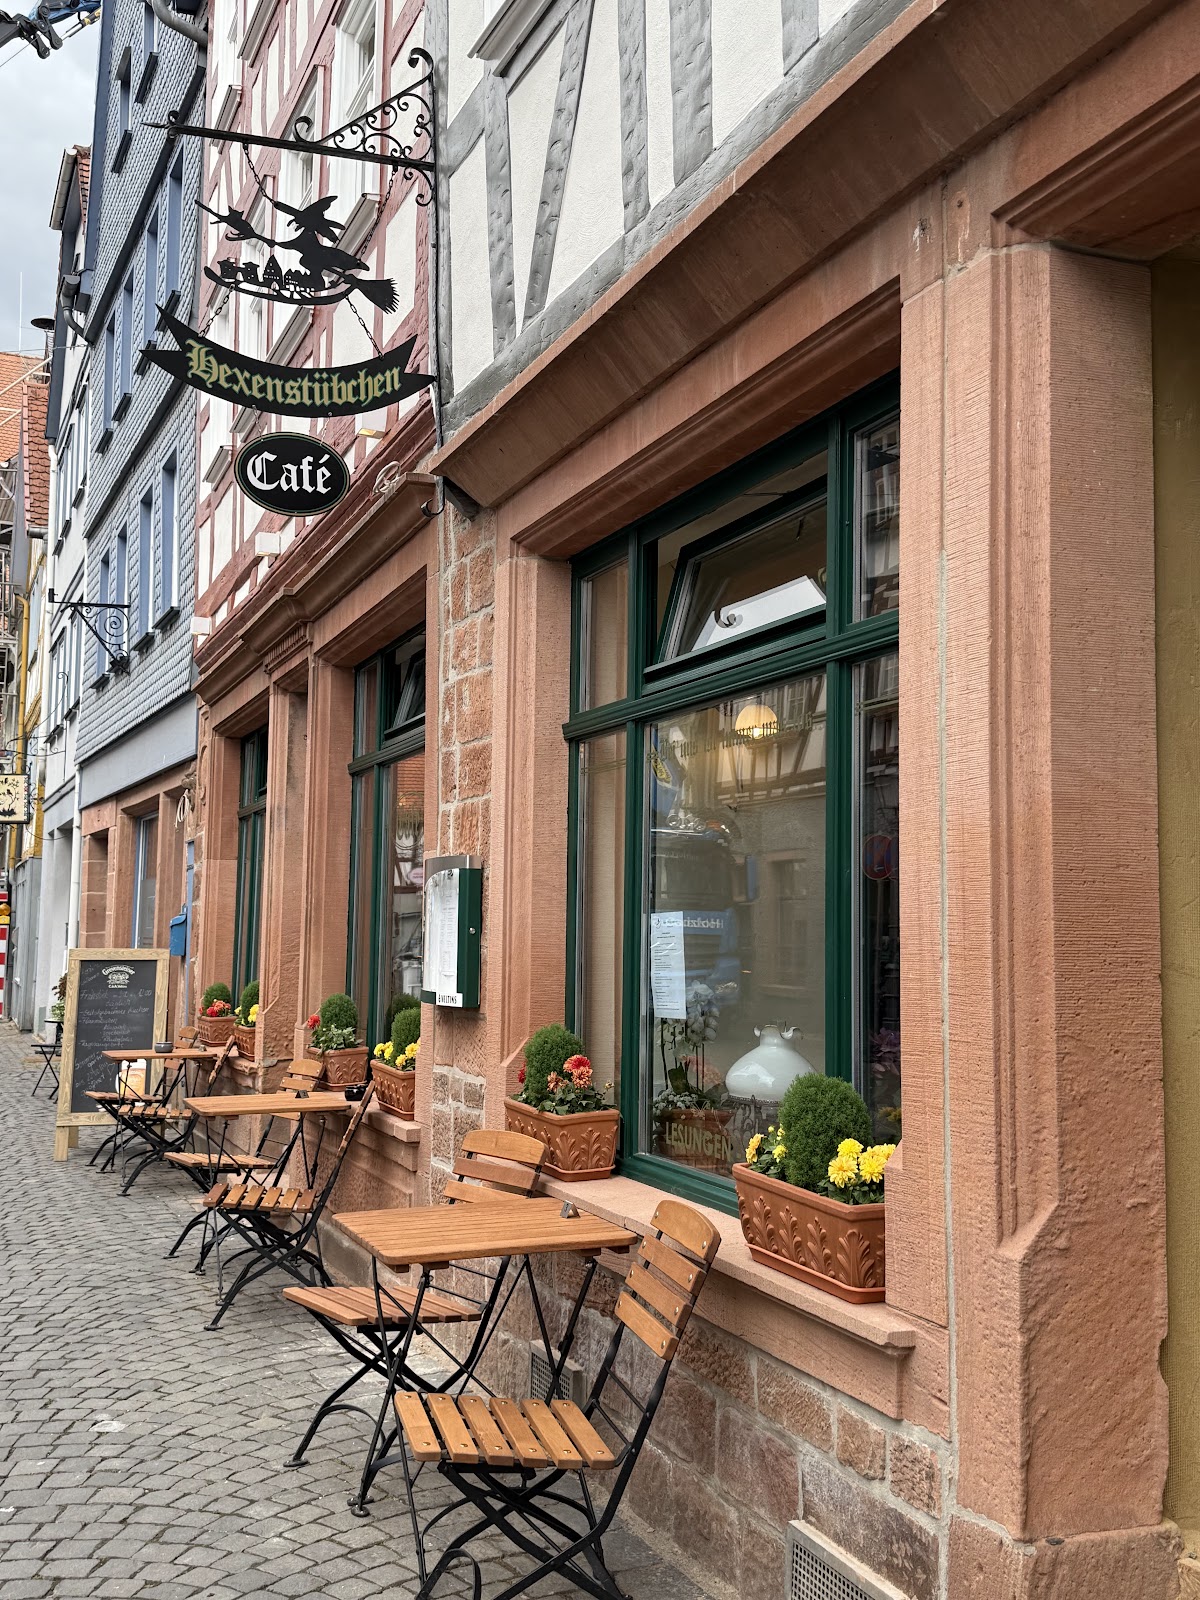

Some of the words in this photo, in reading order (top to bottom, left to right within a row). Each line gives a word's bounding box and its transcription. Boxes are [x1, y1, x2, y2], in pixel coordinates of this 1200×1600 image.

[186, 339, 402, 407] Hexenstübchen
[246, 450, 332, 495] Café
[440, 994, 457, 1005] VELTINS
[665, 1121, 732, 1162] LESUNGEN
